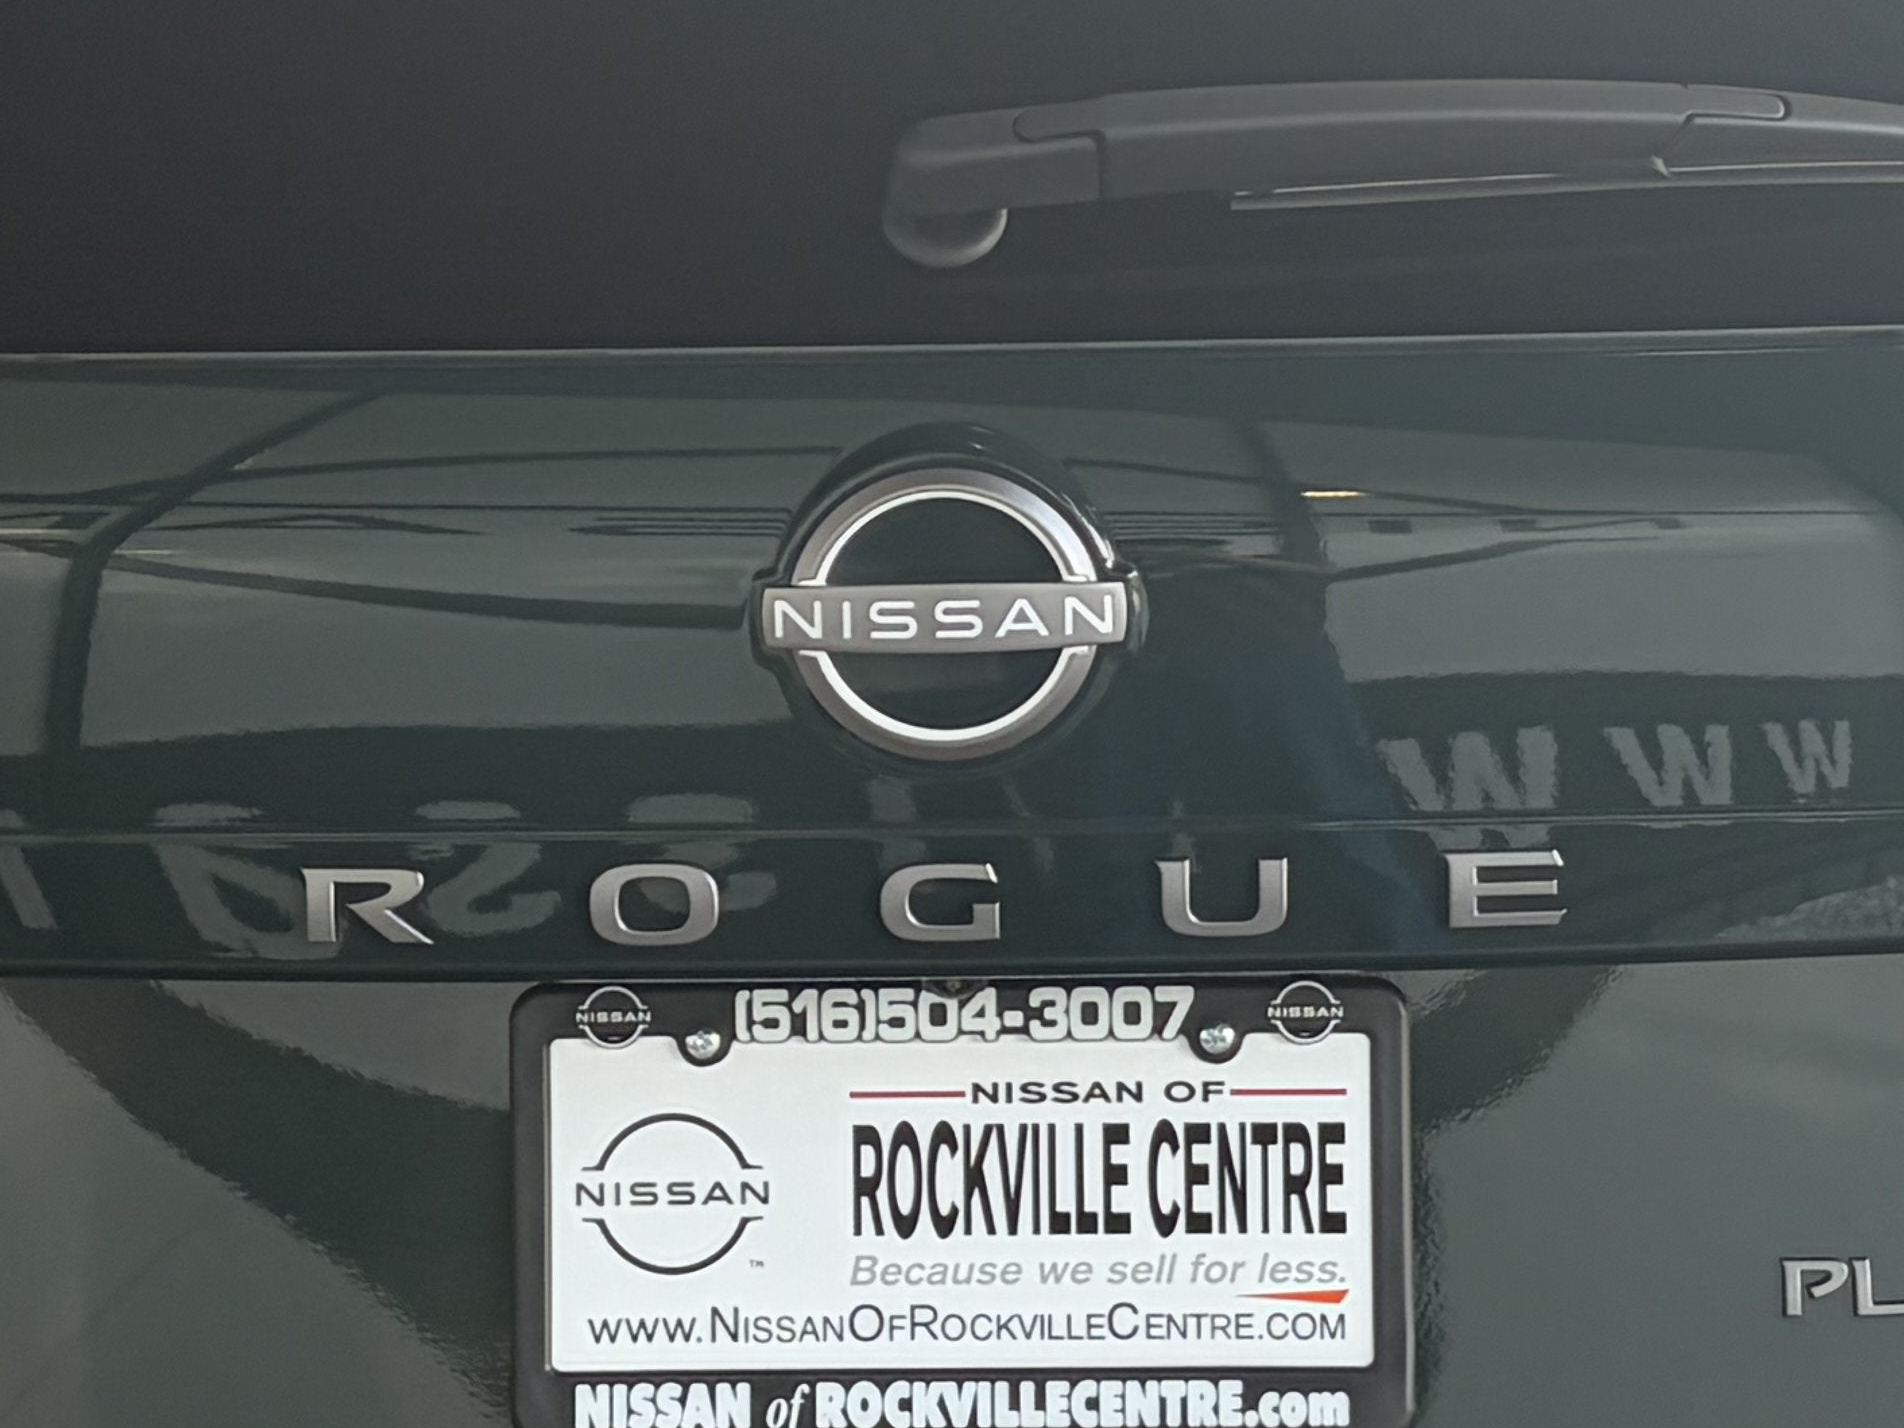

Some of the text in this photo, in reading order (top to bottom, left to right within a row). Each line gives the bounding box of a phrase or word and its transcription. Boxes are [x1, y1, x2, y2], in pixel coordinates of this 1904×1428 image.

[773, 594, 1114, 640] NISSAN
[300, 849, 1568, 946] ROGUE
[575, 1011, 652, 1024] NISSAN
[734, 986, 1196, 1043] (516)504-3007
[1267, 1006, 1345, 1019] NISSAN
[970, 1080, 1226, 1105] NISSAN OF
[576, 1180, 770, 1208] NISSAN
[853, 1118, 1348, 1240] ROCKVILLE CENTRE
[850, 1252, 1347, 1289] Because we sell for less.
